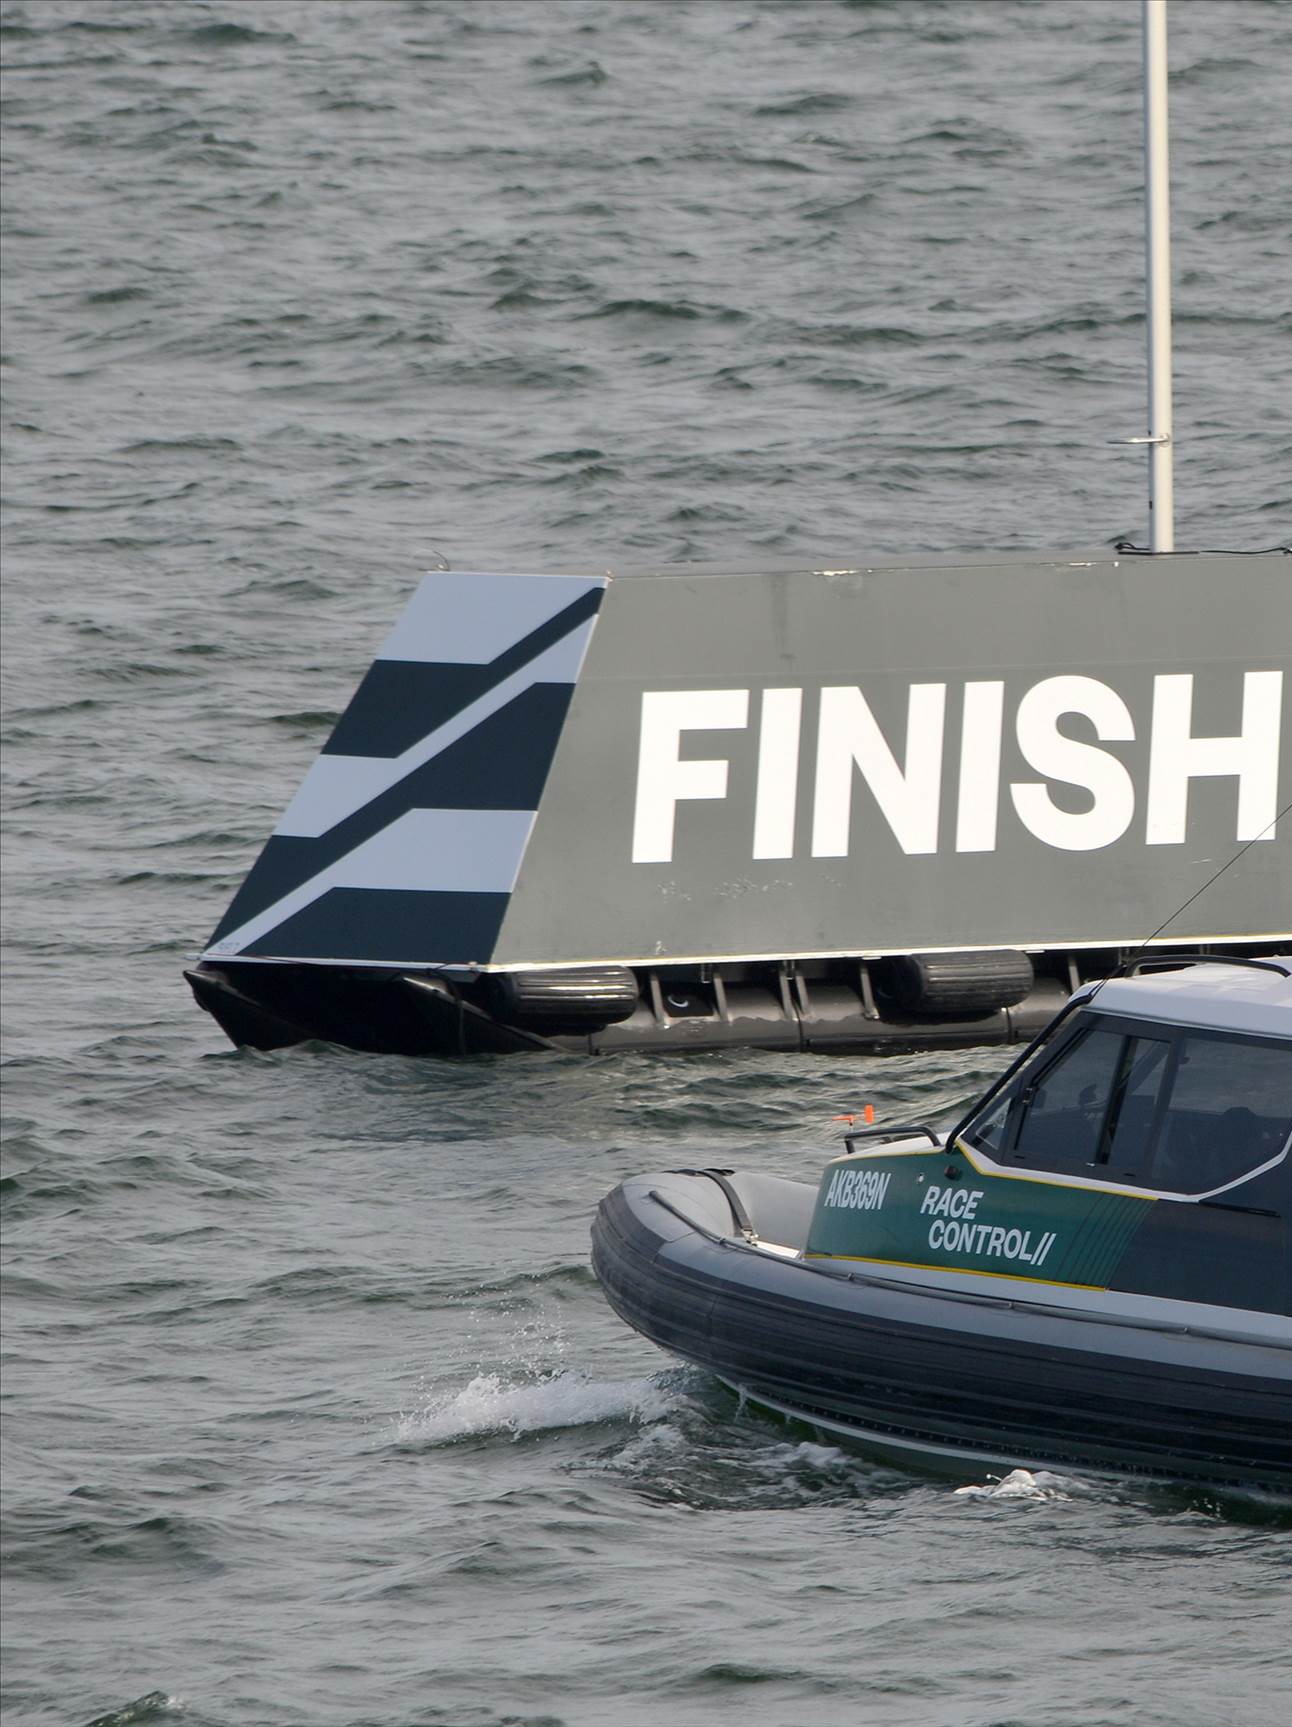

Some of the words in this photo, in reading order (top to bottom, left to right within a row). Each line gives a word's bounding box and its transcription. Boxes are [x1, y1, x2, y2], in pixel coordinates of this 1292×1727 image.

[631, 670, 1284, 864] FINISH
[824, 1169, 892, 1210] AKB369N
[920, 1185, 984, 1220] RACE
